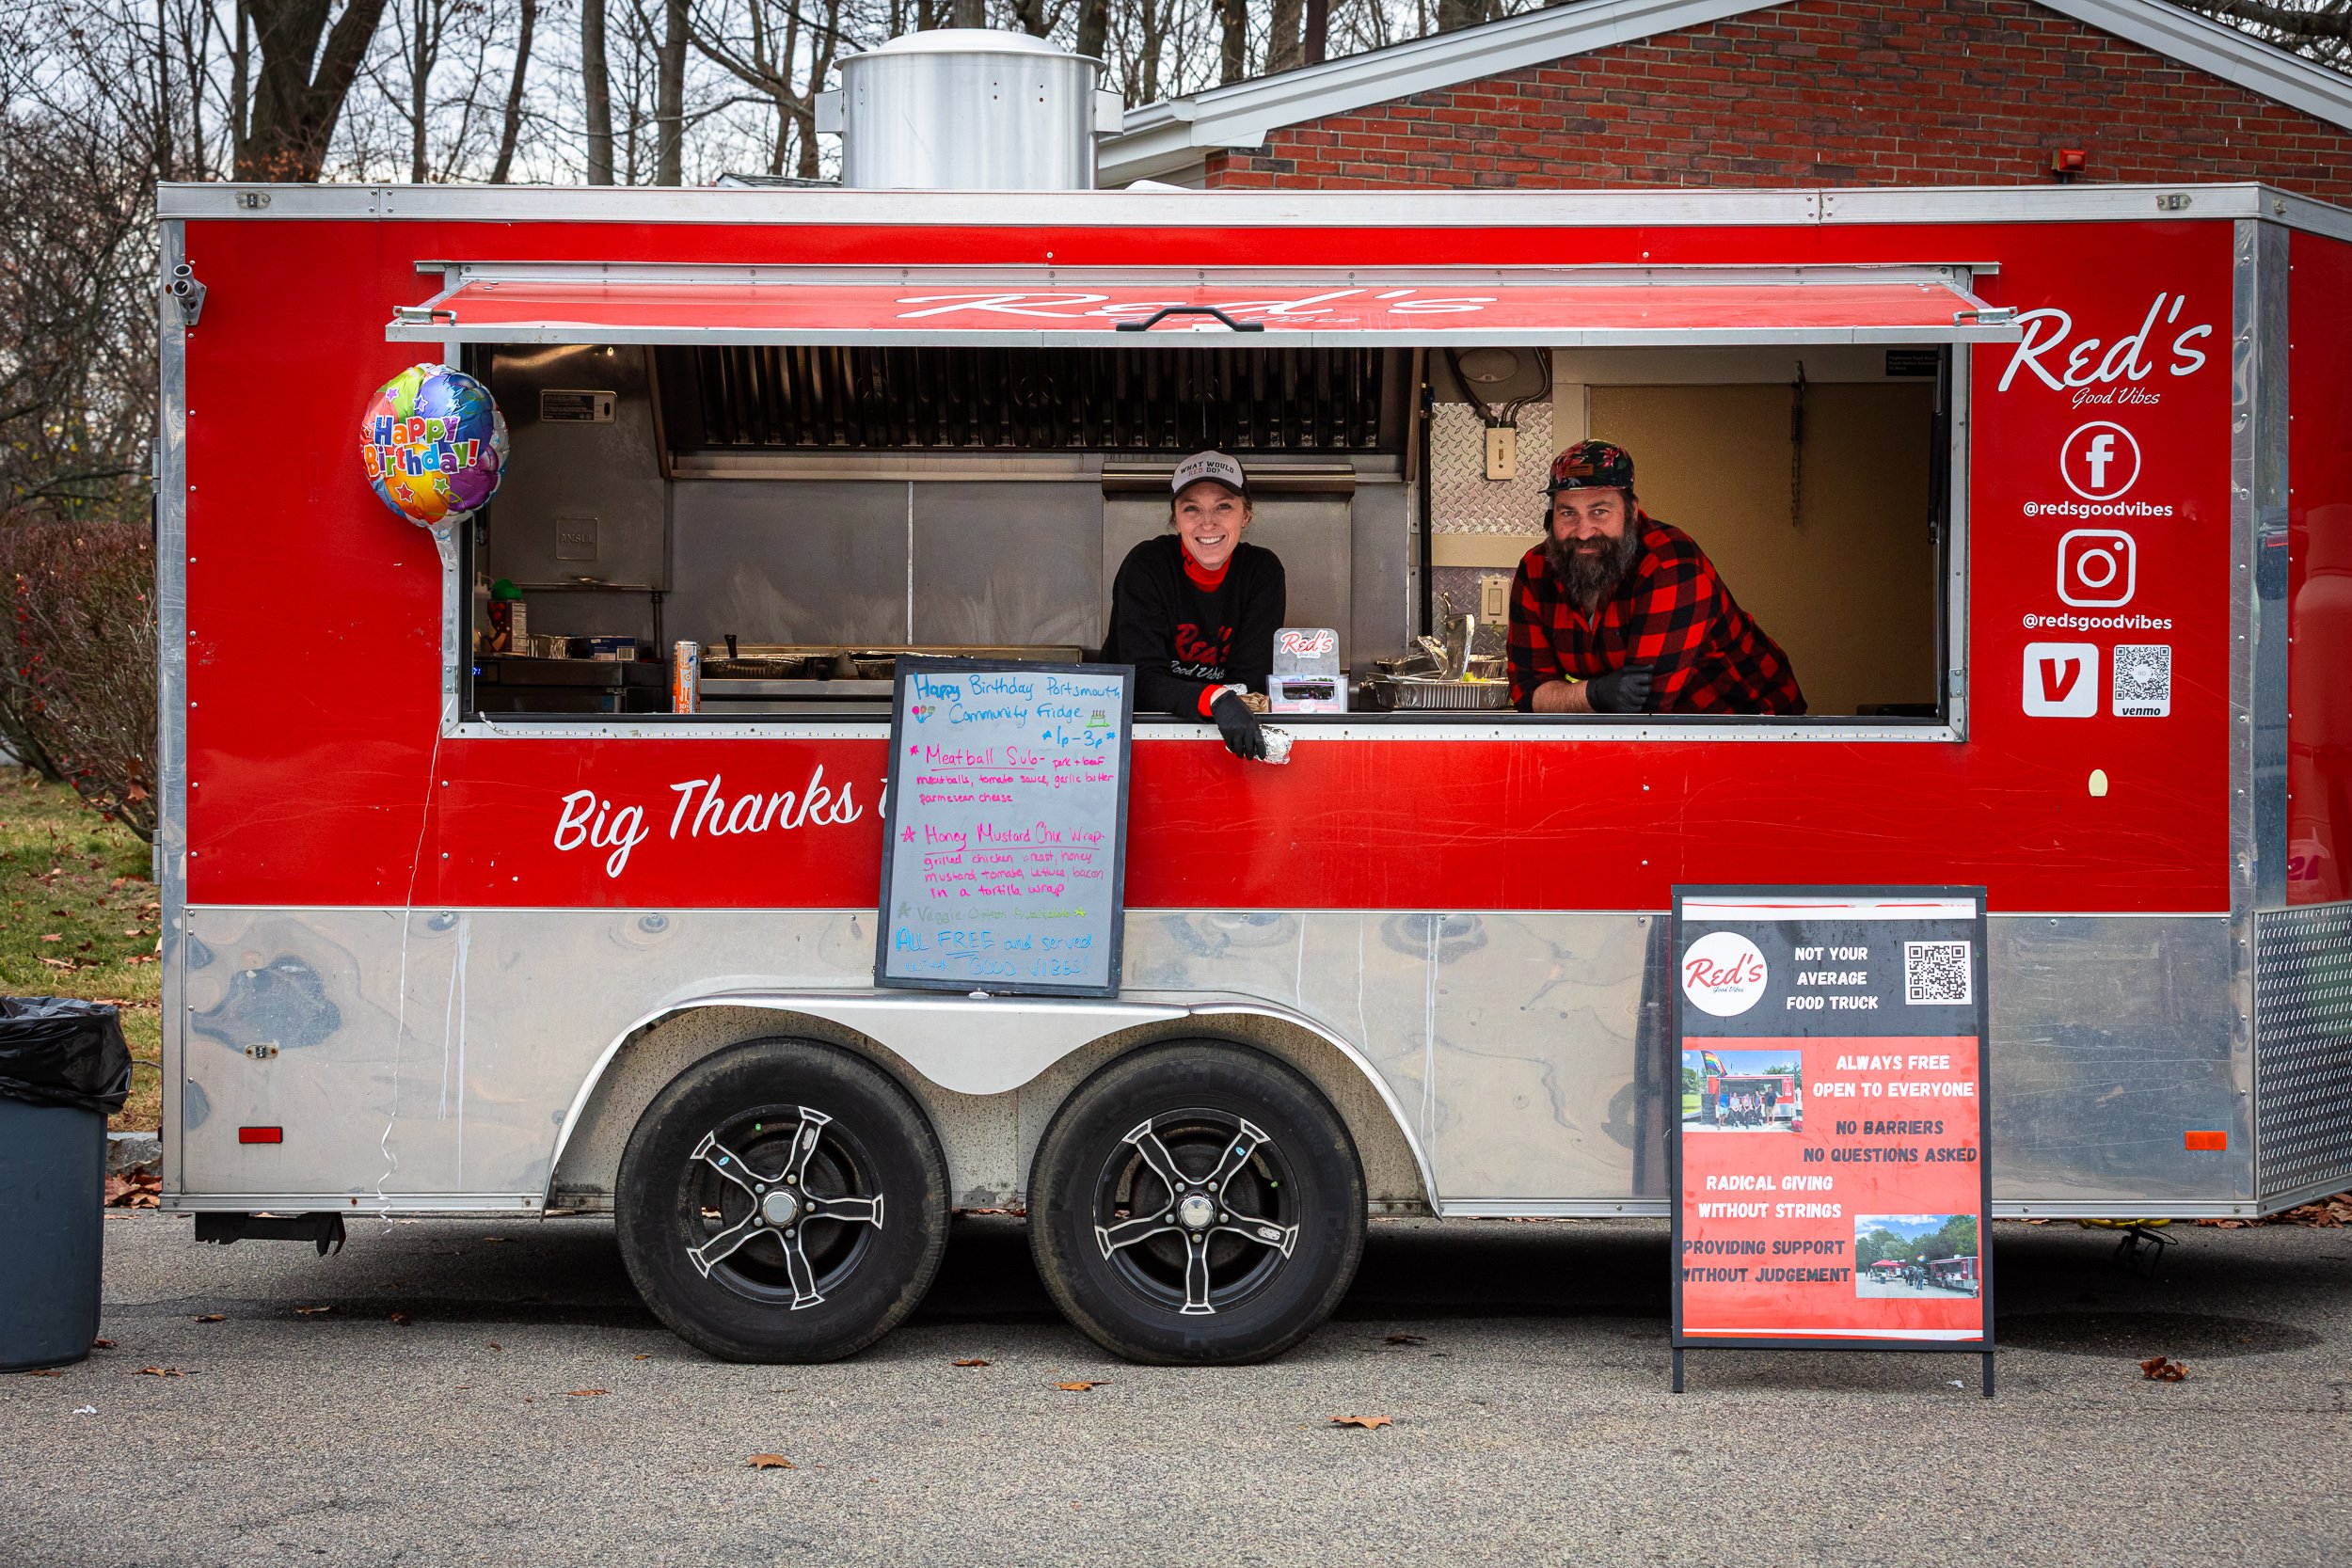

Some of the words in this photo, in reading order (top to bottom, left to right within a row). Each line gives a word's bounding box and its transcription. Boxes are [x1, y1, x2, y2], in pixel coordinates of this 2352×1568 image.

[1997, 292, 2213, 392] Red's
[2072, 388, 2114, 410] Good
[2116, 387, 2161, 405] Vibes
[373, 416, 461, 447] Happy
[362, 438, 481, 478] Birthday!
[1181, 461, 1204, 474] WHAT
[1206, 461, 1234, 474] WOULD
[1188, 467, 1203, 477] RED
[2023, 501, 2173, 518] @redsgoodvibes
[2023, 613, 2172, 631] @redsgoodvibes
[1280, 630, 1333, 654] Red's
[913, 672, 961, 702] Happy
[969, 674, 1034, 701] Birthday
[1046, 676, 1120, 698] Portsmouth
[948, 703, 1028, 729] Community
[1036, 703, 1084, 723] Fridge
[2122, 706, 2161, 716] venmo
[925, 742, 994, 766] Meatball
[978, 773, 1014, 784] tomato
[1054, 773, 1081, 788] garlic
[1085, 771, 1115, 783] butter
[552, 788, 650, 879] Big
[669, 764, 864, 841] Thanks
[925, 823, 967, 852] Honey
[977, 822, 1031, 843] Mustard
[923, 853, 962, 872] grilled
[971, 853, 1013, 863] chicken
[1060, 849, 1092, 864] honey
[1072, 864, 1104, 880] bacon
[959, 888, 971, 897] a
[977, 883, 1024, 896] tortilla
[1027, 883, 1066, 897] wrap
[937, 930, 995, 950] FREE
[1004, 932, 1032, 951] and
[1041, 932, 1093, 952] served
[1794, 947, 1824, 961] NOT
[1828, 946, 1868, 961] YOUR
[905, 958, 949, 973] with
[969, 956, 1016, 976] GOOD
[1024, 954, 1089, 977] VIBES!
[1685, 952, 1764, 989] Red's
[1797, 971, 1867, 986] AVERAGE
[1712, 985, 1727, 993] Good
[1728, 985, 1744, 993] Vibes
[1787, 996, 1824, 1010] FOOD
[1829, 996, 1879, 1010] TRUCK
[1836, 1054, 1902, 1070] ALWAYS
[1908, 1054, 1950, 1070] FREE
[1813, 1082, 1856, 1098] OPEN
[1860, 1082, 1883, 1097] TO
[1887, 1082, 1975, 1097] EVERYONE
[1836, 1120, 1857, 1135] NO
[1863, 1120, 1944, 1134] BARRIERS
[1804, 1148, 1825, 1163] NO
[1831, 1148, 1918, 1163] QUESTIONS
[1925, 1148, 1978, 1162] ASKED
[1706, 1176, 1776, 1191] RADICAL
[1781, 1175, 1834, 1191] GIVING
[1698, 1203, 1769, 1219] WITHOUT
[1775, 1202, 1842, 1218] STRINGS
[1683, 1240, 1766, 1255] PROVIDING
[1772, 1240, 1845, 1255] SUPPORT
[1755, 1267, 1851, 1283] JUDGEMENT
